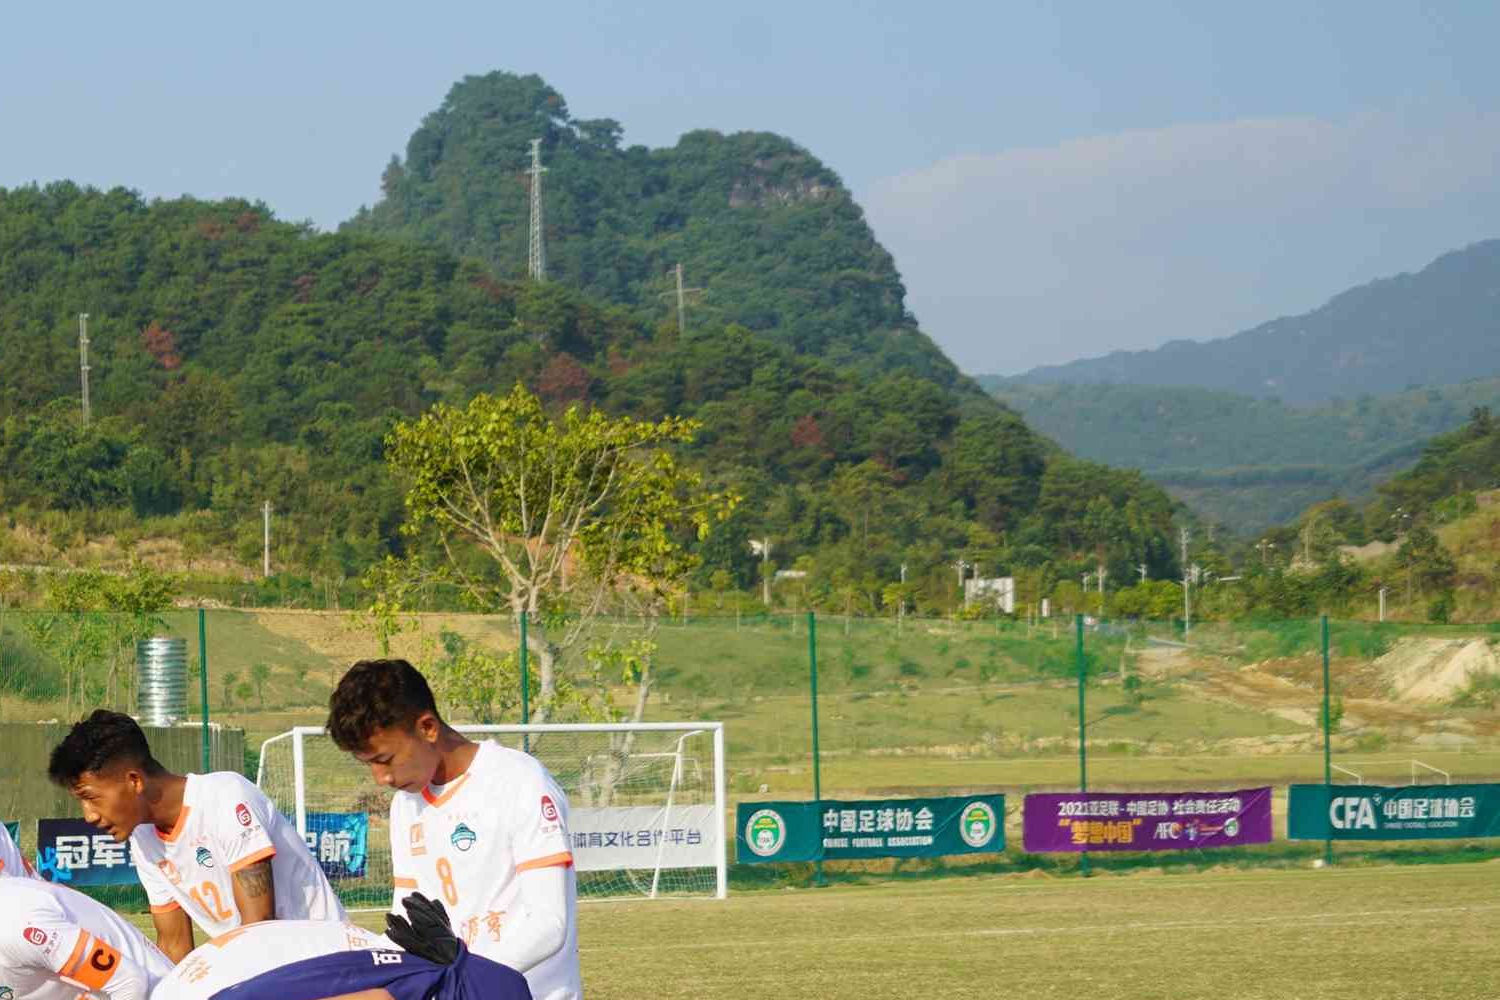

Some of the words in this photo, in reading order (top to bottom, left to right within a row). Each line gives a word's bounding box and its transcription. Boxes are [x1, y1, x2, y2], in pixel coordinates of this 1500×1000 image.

[823, 807, 934, 832] 中国足球协会
[1330, 797, 1377, 829] CFA
[1383, 797, 1476, 818] 中国足球协会
[568, 829, 702, 849] 体育文化合作平台
[189, 880, 233, 922] 12
[92, 948, 113, 971] C
